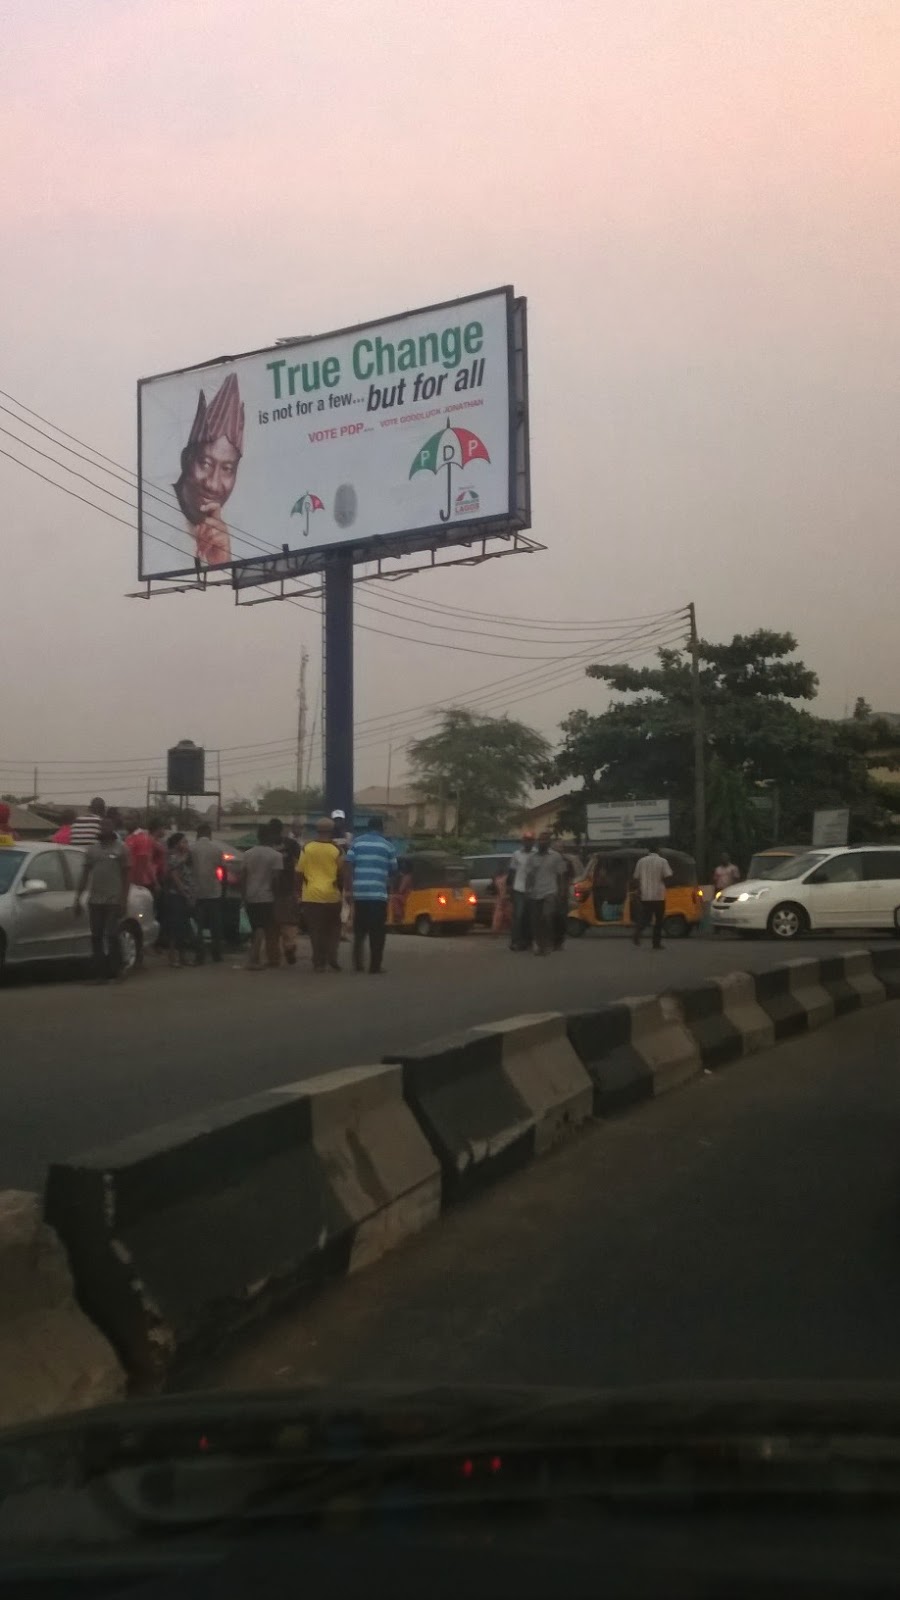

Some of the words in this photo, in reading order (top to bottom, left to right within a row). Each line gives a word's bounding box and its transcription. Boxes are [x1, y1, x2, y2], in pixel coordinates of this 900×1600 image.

[266, 357, 341, 399] True
[352, 321, 484, 380] Change
[259, 410, 269, 424] is
[272, 403, 293, 421] not
[296, 400, 314, 416] for
[317, 399, 325, 411] a
[366, 378, 407, 411] but
[412, 372, 449, 402] for
[454, 358, 486, 391] all
[308, 428, 338, 443] VOTE
[380, 418, 399, 428] VOTE
[400, 408, 441, 424] GOODLUCK
[443, 398, 484, 414] JONATHAN
[420, 450, 431, 467] P
[443, 444, 455, 462] D
[468, 439, 478, 457] P
